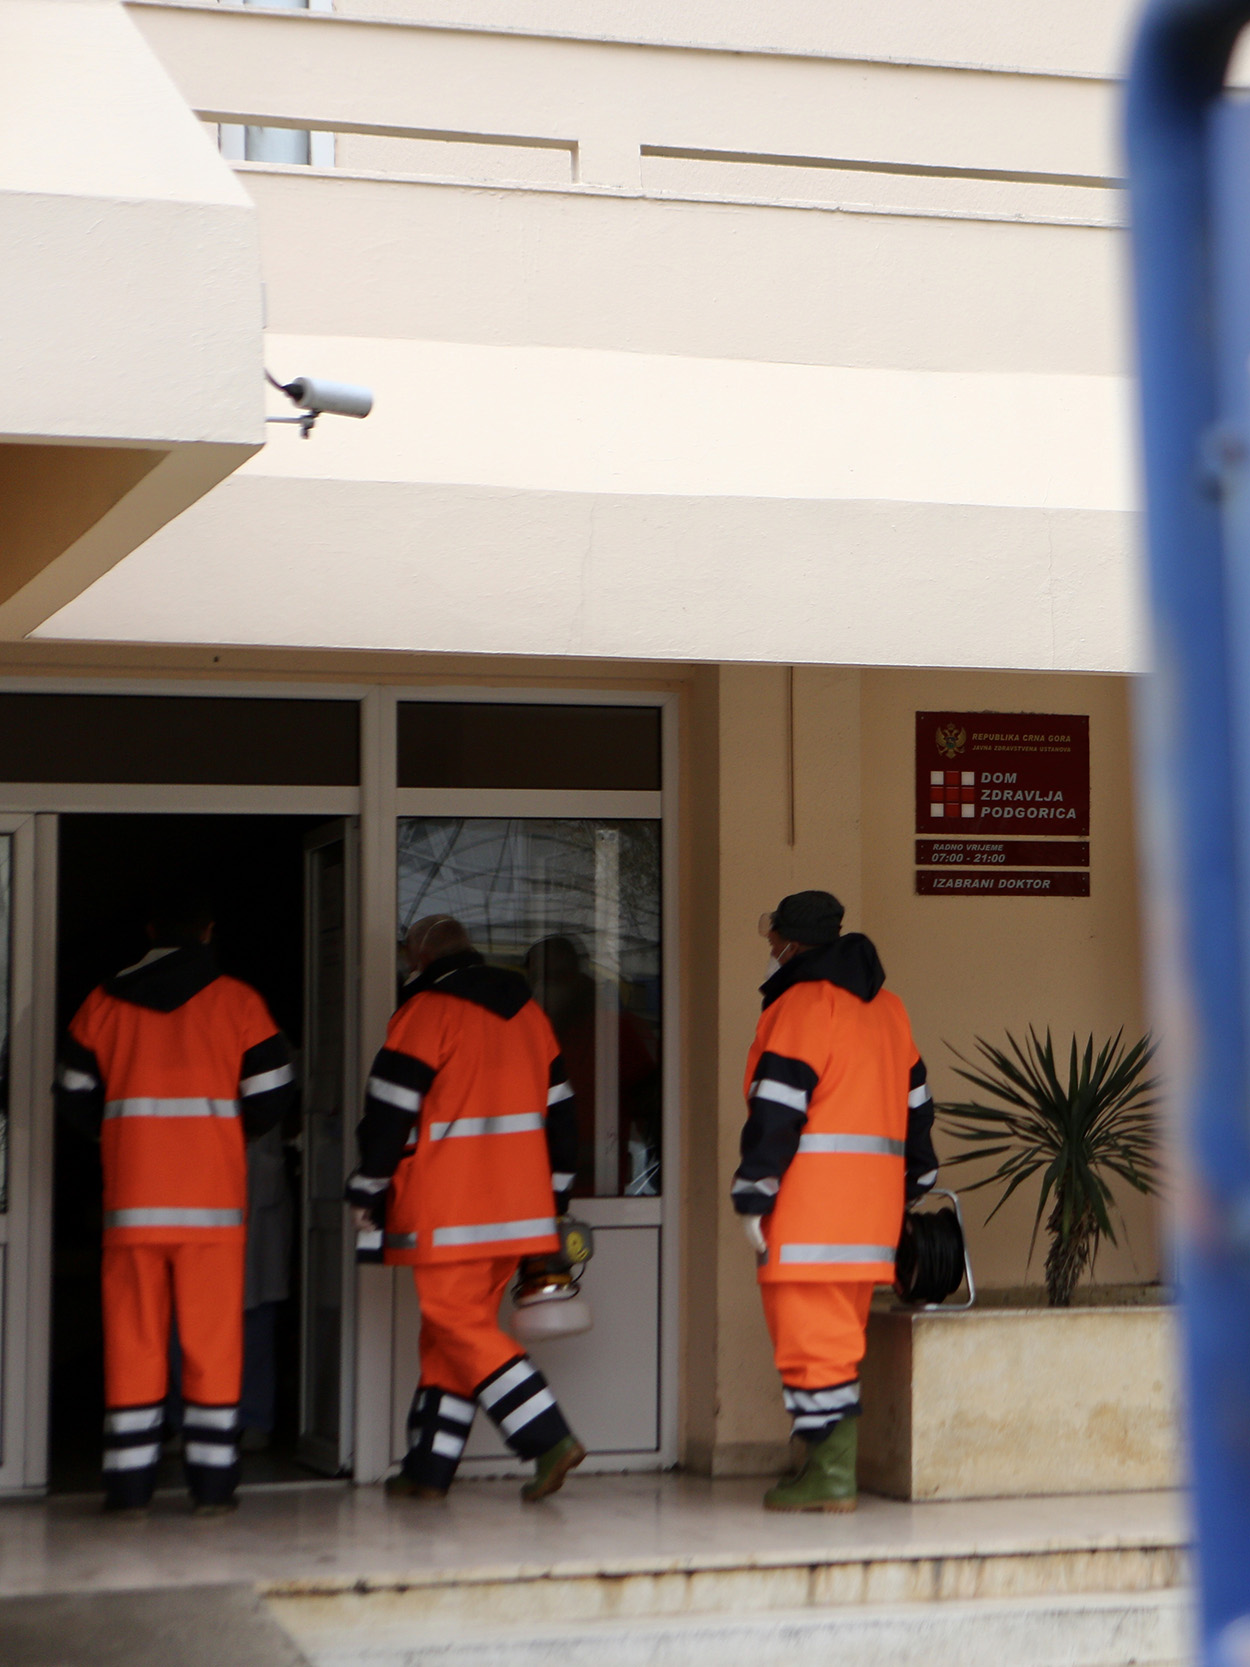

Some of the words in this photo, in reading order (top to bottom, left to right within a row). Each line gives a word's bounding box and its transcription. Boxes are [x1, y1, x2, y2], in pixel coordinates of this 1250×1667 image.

[972, 733, 1019, 741] REPUBLIKA
[1023, 734, 1045, 742] CRNA
[981, 772, 1017, 783] DOM
[981, 790, 1063, 801] ZDRAVLJA
[981, 807, 1076, 818] PODGORICA
[932, 854, 963, 862] 07:00
[974, 854, 1005, 863] 21:00
[933, 879, 994, 888] IZABRANI
[998, 880, 1051, 888] DOKTOR
